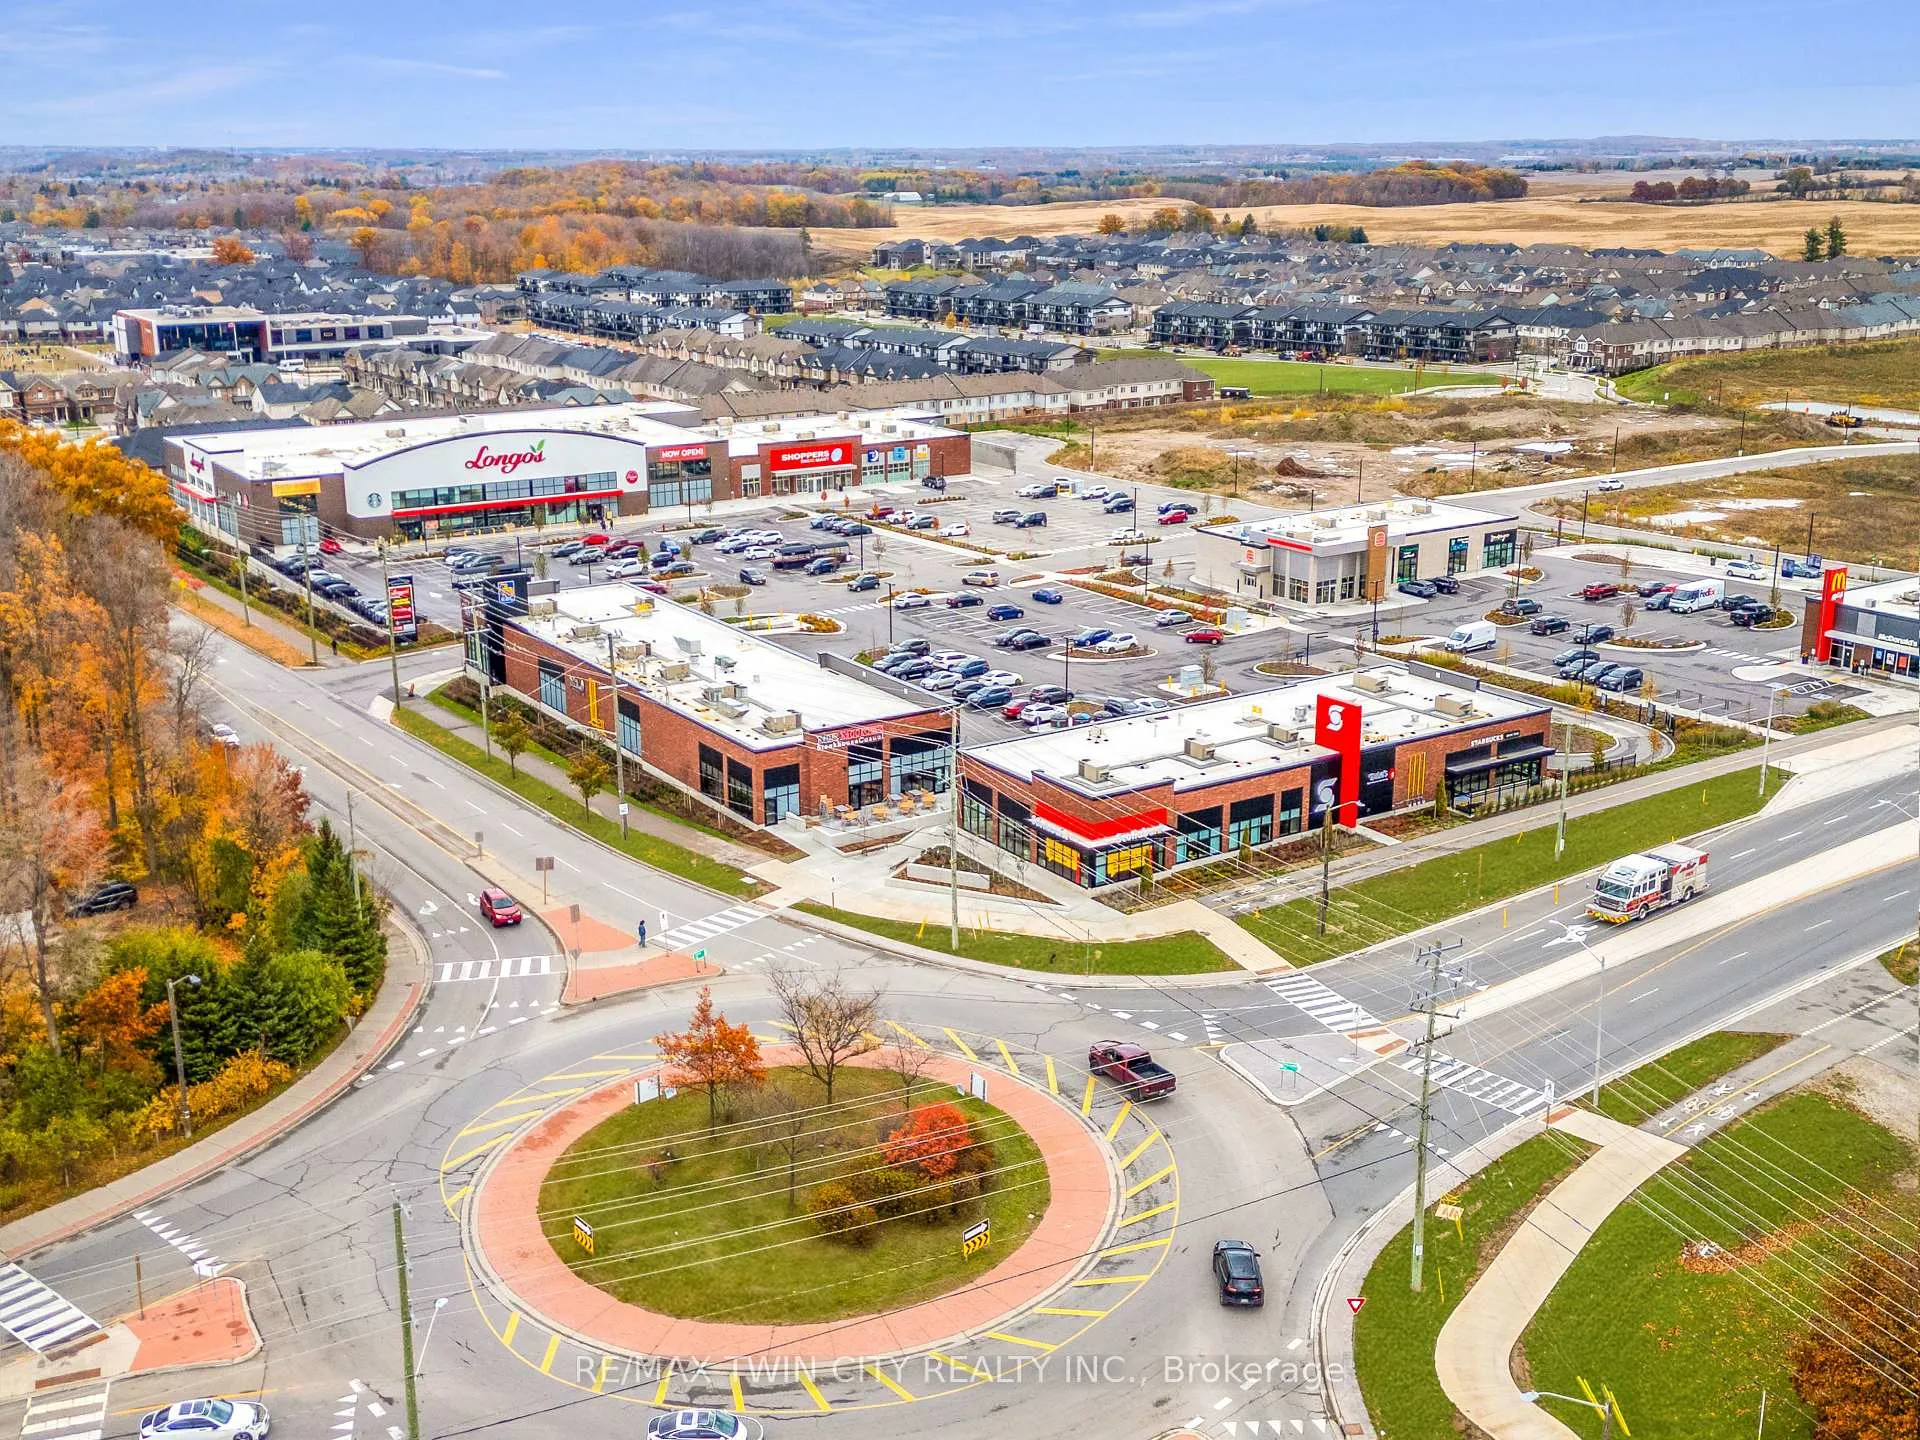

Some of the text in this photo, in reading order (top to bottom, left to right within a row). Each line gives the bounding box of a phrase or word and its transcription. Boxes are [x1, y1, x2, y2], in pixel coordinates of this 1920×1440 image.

[661, 450, 680, 458] NOW
[781, 450, 829, 461] SHOPPERS
[1700, 588, 1715, 598] FedEx
[1877, 633, 1918, 647] McDonald's
[1470, 734, 1504, 747] STARBUCKS
